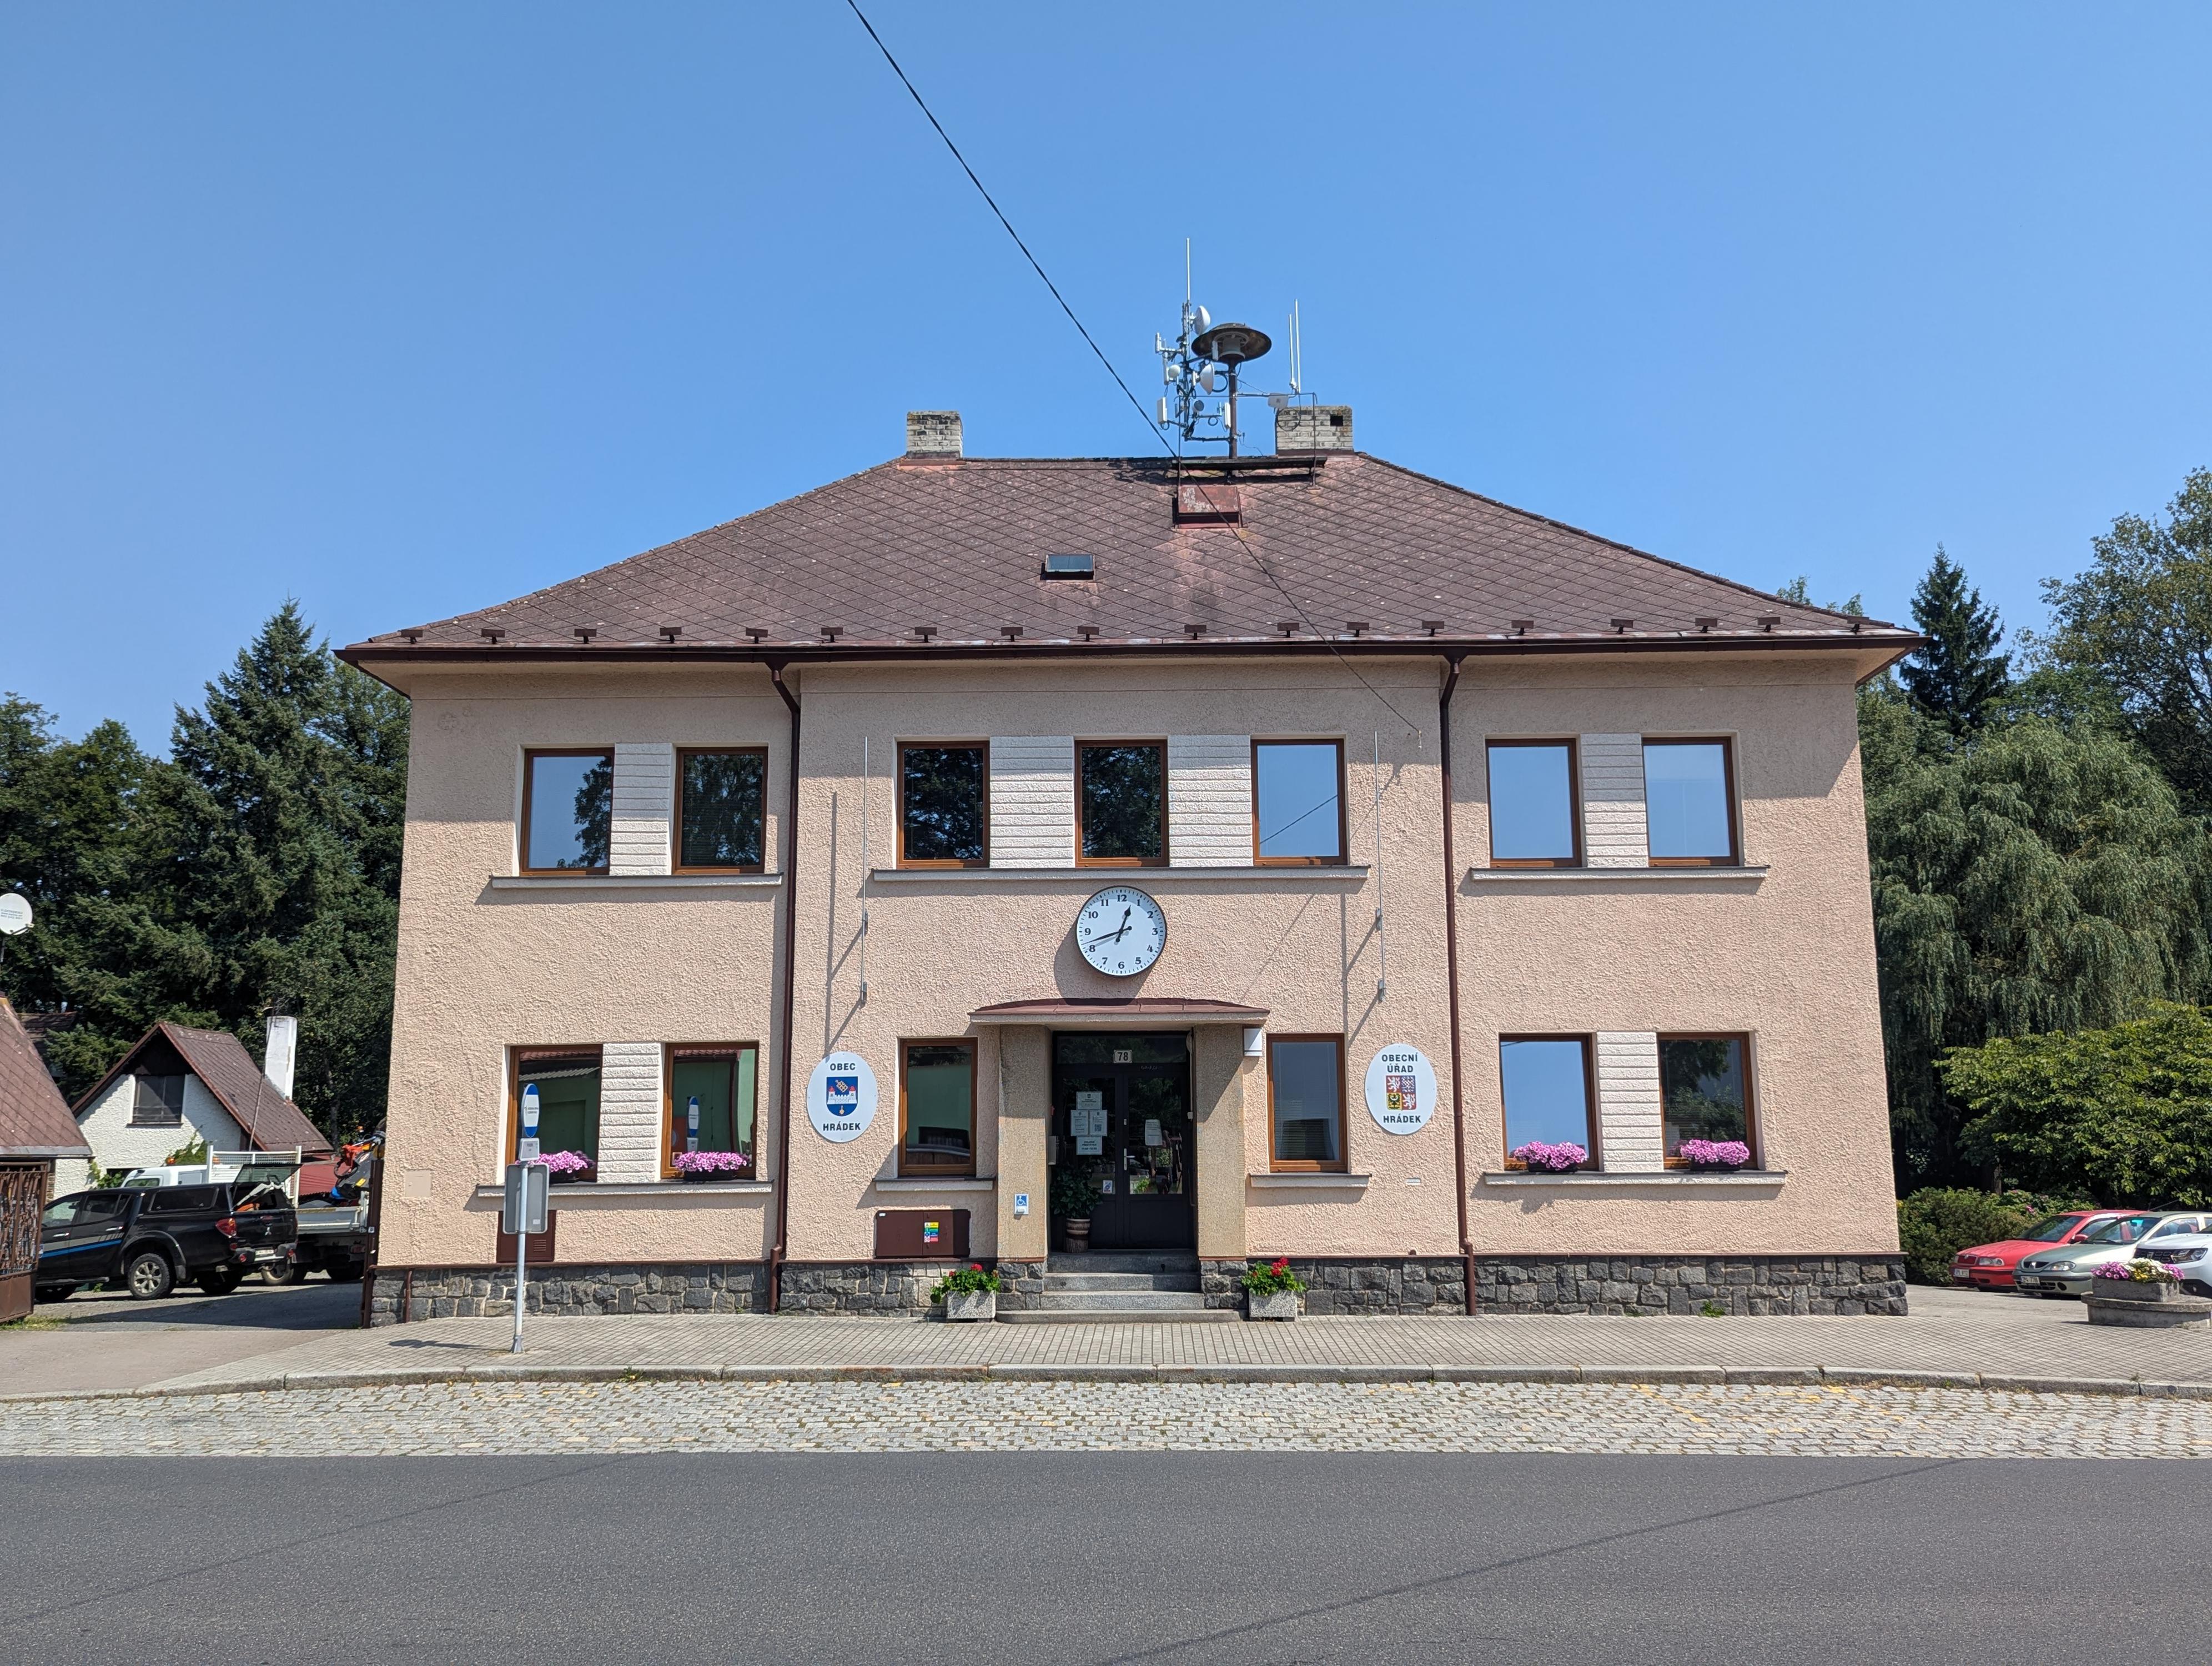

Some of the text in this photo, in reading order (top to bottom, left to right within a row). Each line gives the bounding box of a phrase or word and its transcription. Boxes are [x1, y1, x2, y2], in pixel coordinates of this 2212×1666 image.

[1117, 1052, 1128, 1061] 78
[1381, 1052, 1418, 1062] OBECNÍ
[1387, 1063, 1414, 1073] ÚŘAD
[1383, 1113, 1421, 1123] HRÁDEK
[823, 1121, 861, 1131] HRÁDEK
